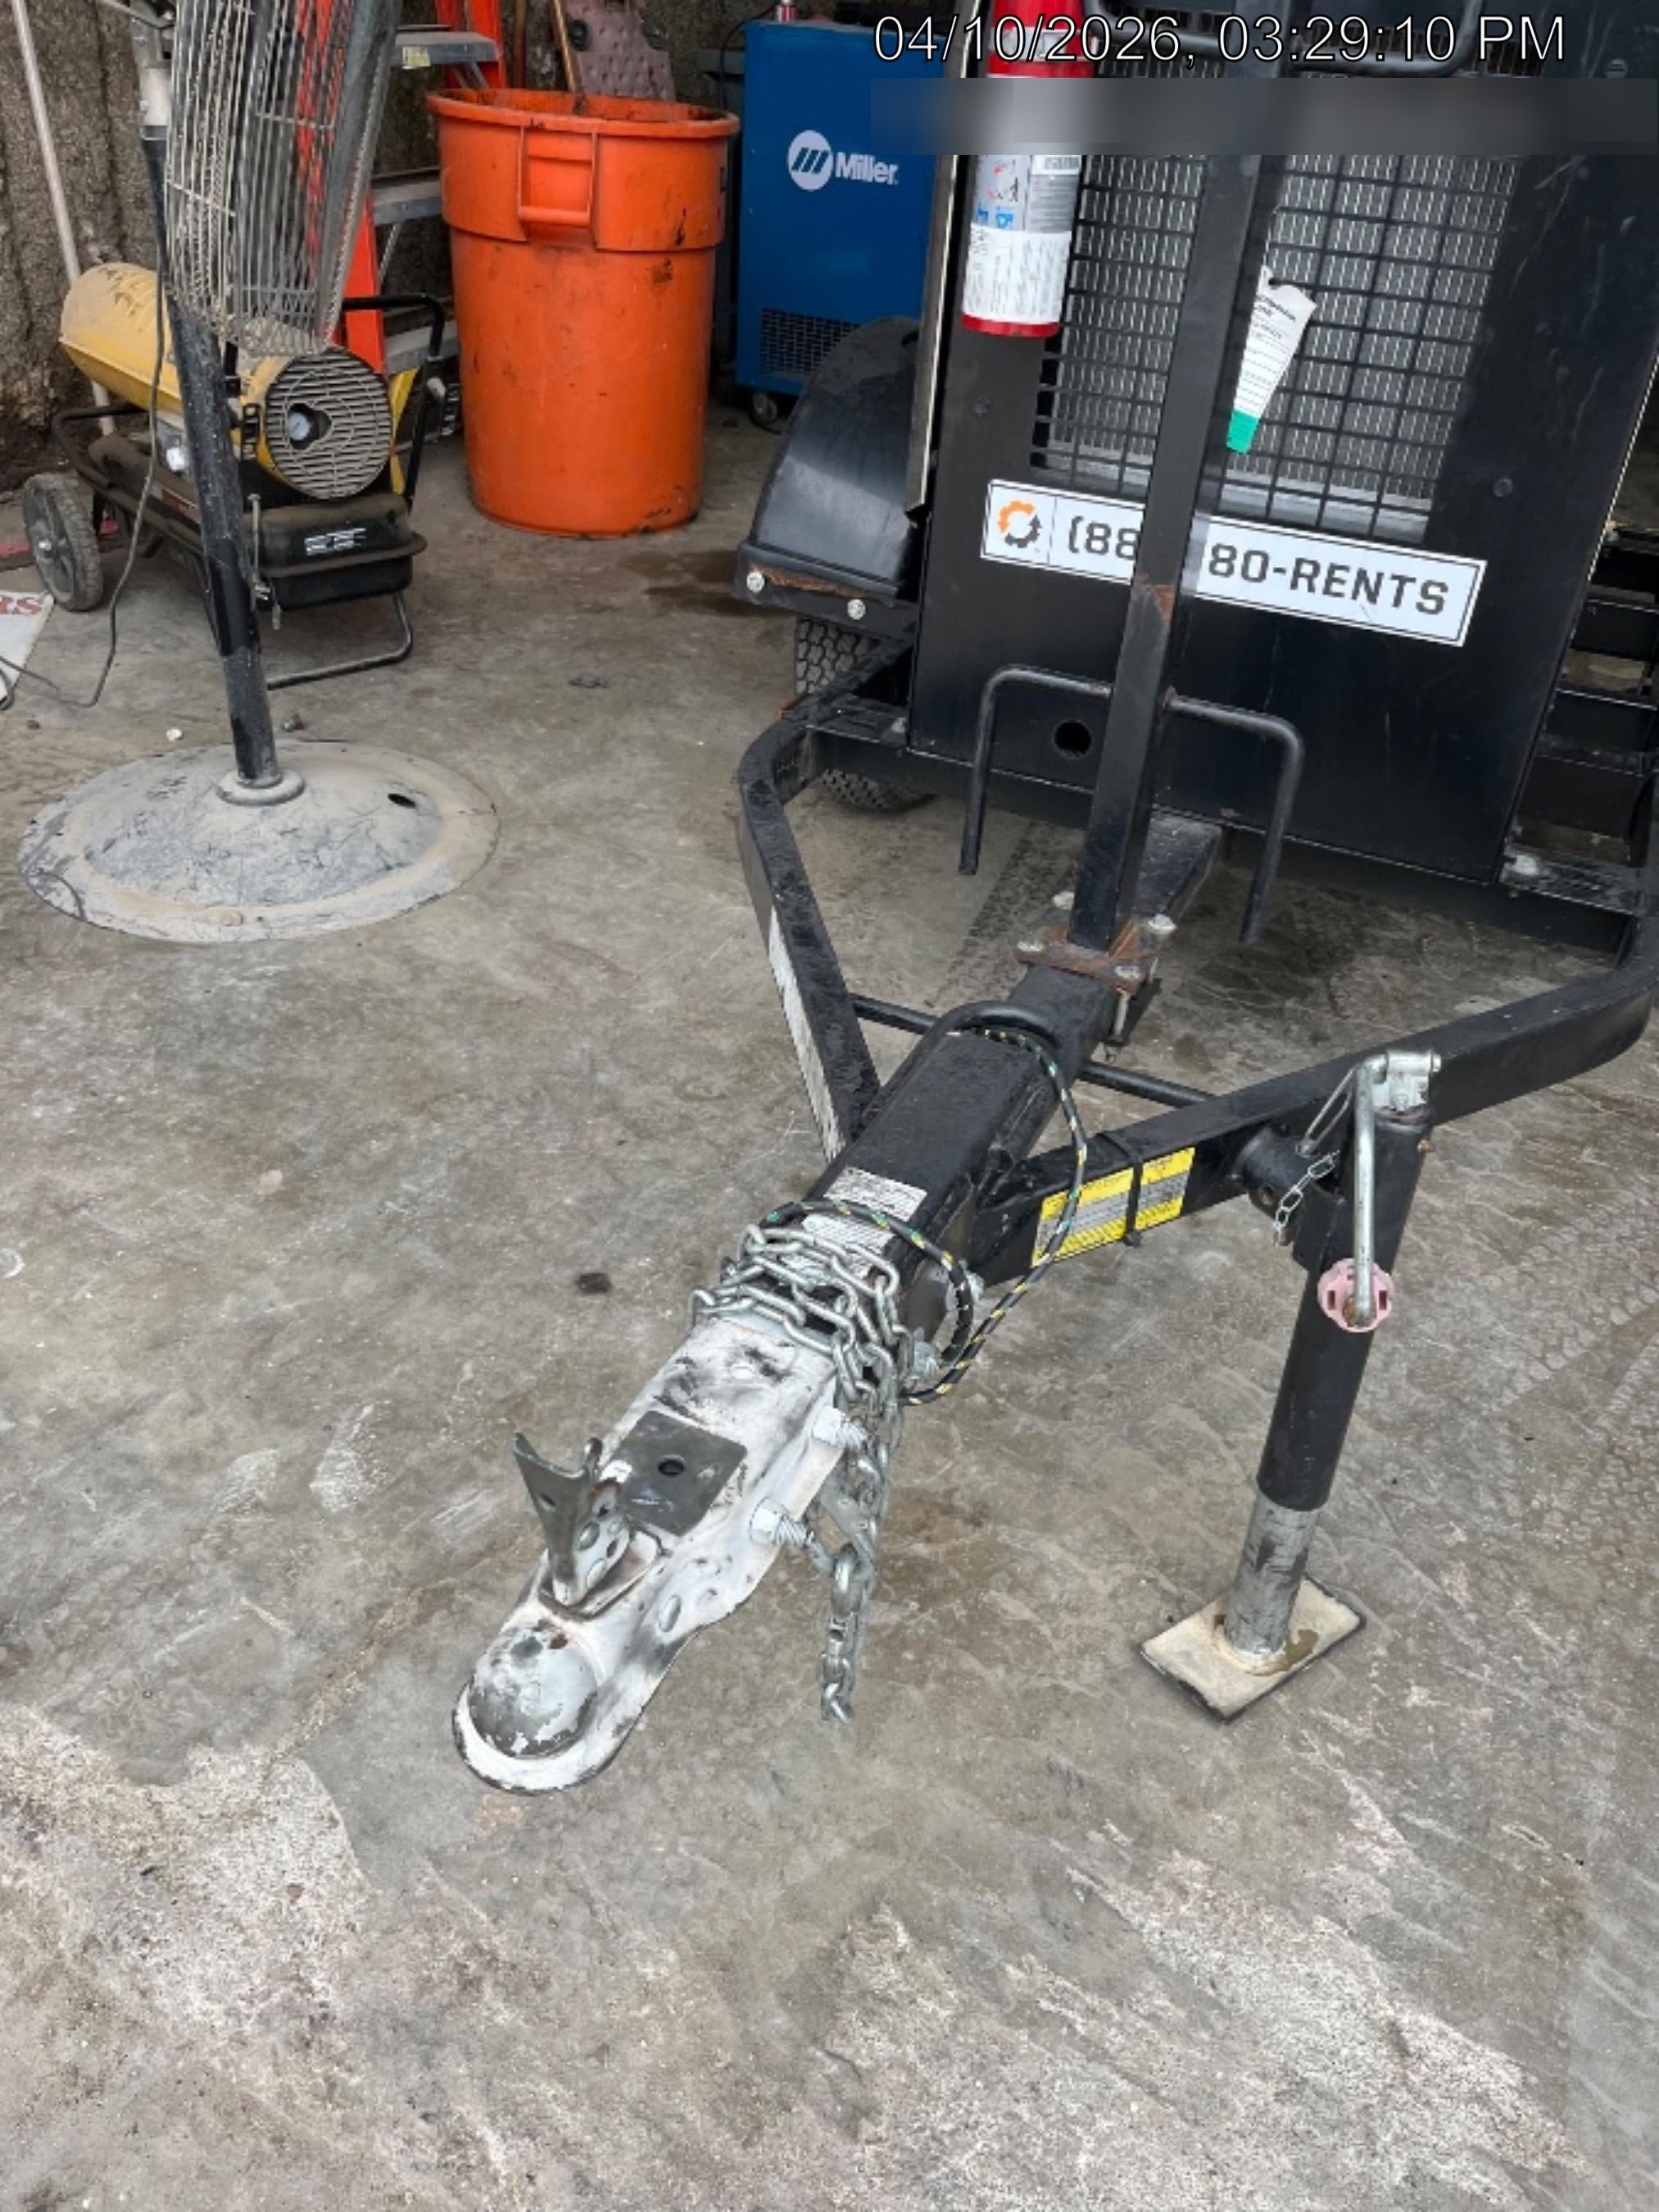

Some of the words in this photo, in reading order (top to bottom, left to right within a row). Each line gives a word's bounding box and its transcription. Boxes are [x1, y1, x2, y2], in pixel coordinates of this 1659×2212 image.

[835, 152, 898, 185] Miller
[1068, 515, 1142, 560] (88
[1208, 542, 1449, 615] 80-RENTS
